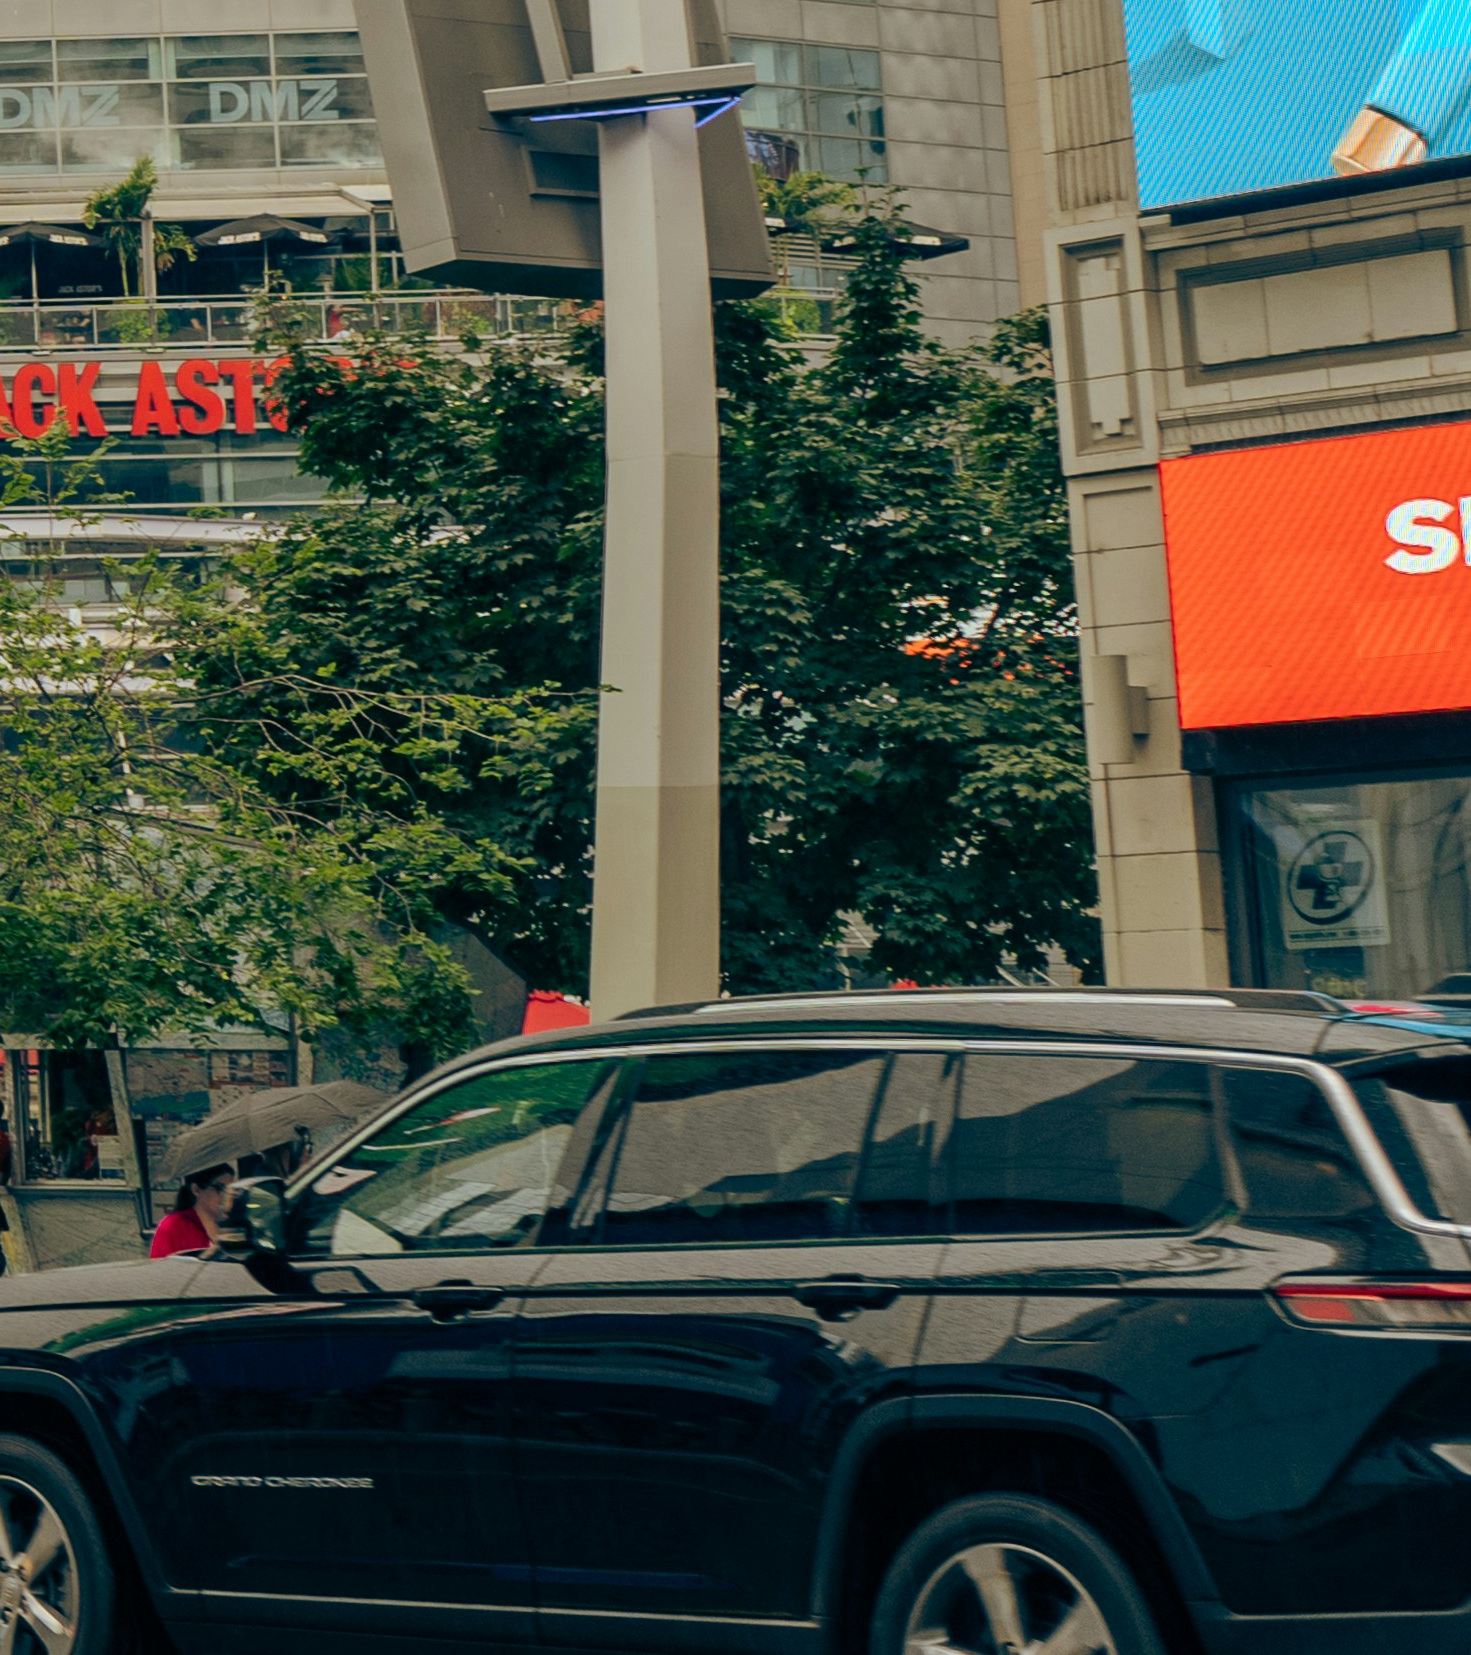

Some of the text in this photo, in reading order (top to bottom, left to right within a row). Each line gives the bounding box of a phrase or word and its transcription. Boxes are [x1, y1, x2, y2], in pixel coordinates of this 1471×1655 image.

[210, 79, 340, 124] DMZ
[190, 1475, 375, 1490] GRAND CHEROKEE
